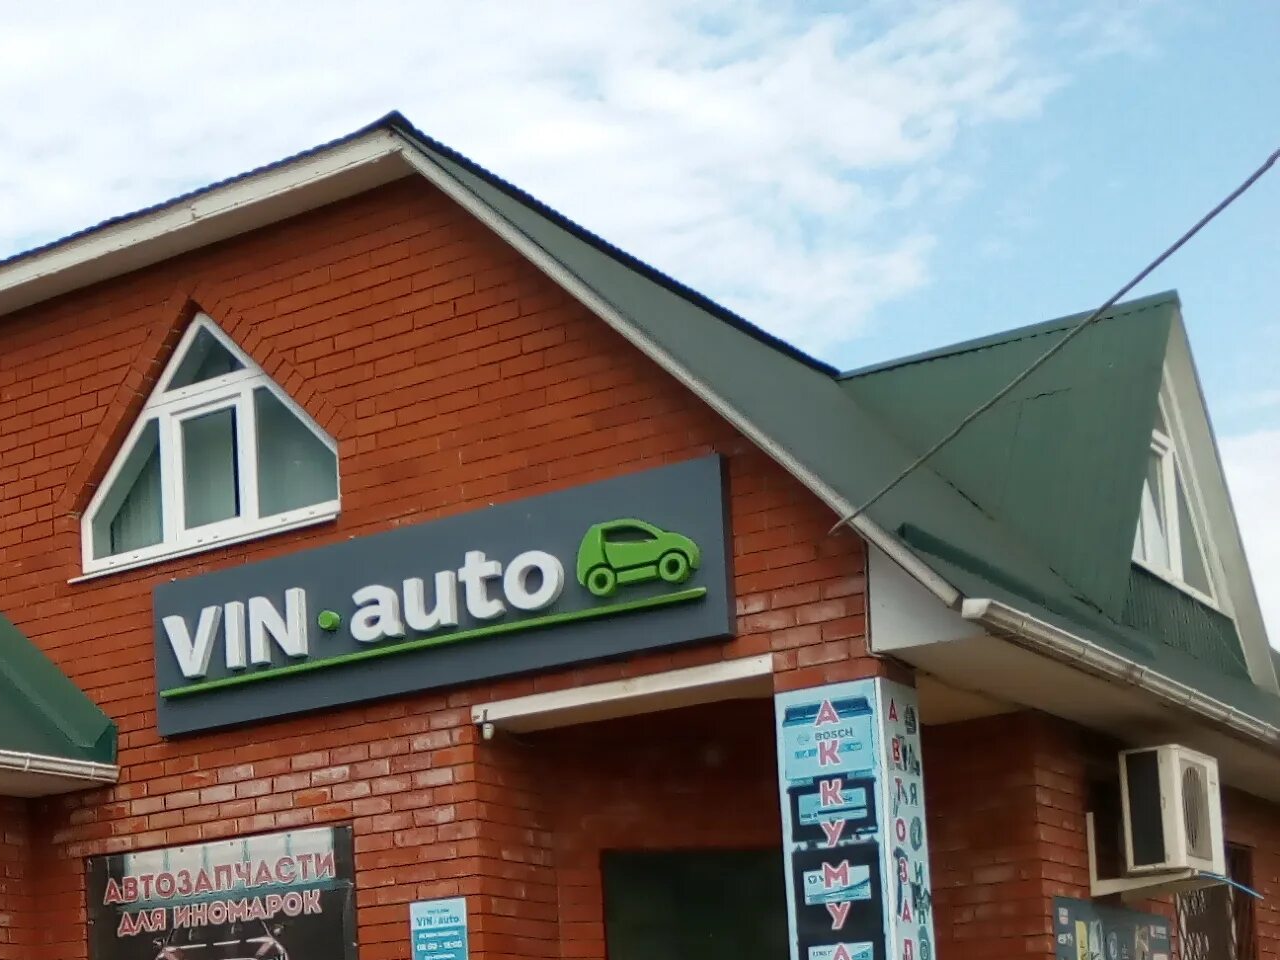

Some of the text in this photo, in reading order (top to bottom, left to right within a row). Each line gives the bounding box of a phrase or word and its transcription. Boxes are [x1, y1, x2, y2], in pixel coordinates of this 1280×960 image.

[162, 550, 564, 678] VIN auto
[103, 851, 336, 905] АВТОЗАПЧАСТИ
[117, 889, 322, 937] ДЛЯ ИНОМАРОК
